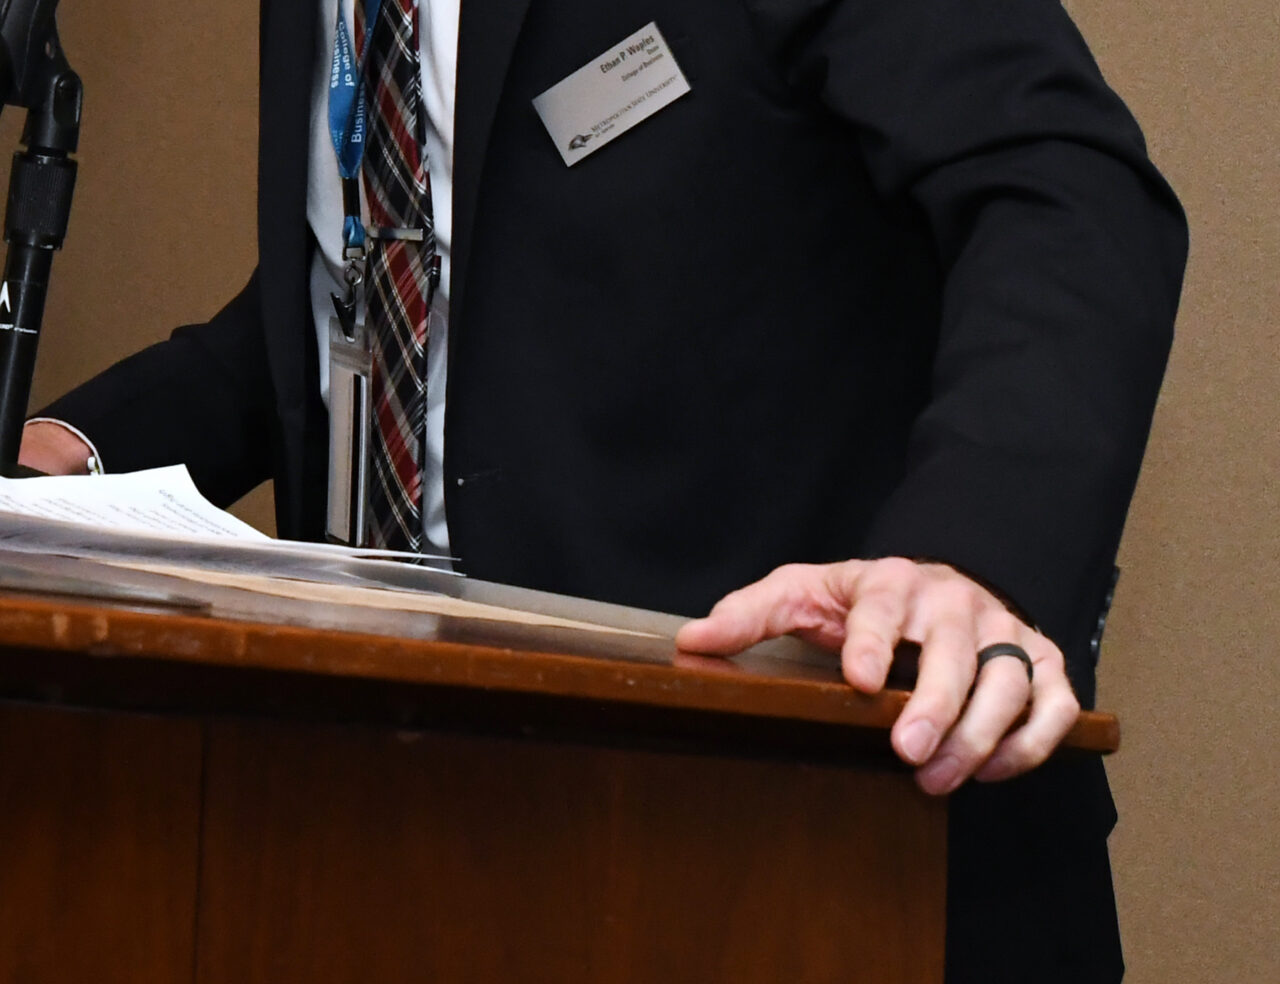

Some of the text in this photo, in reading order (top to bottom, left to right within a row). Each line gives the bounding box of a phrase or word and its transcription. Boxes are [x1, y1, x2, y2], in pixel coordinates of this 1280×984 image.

[600, 57, 621, 74] Ethan
[626, 35, 654, 56] Waples
[345, 74, 356, 87] of
